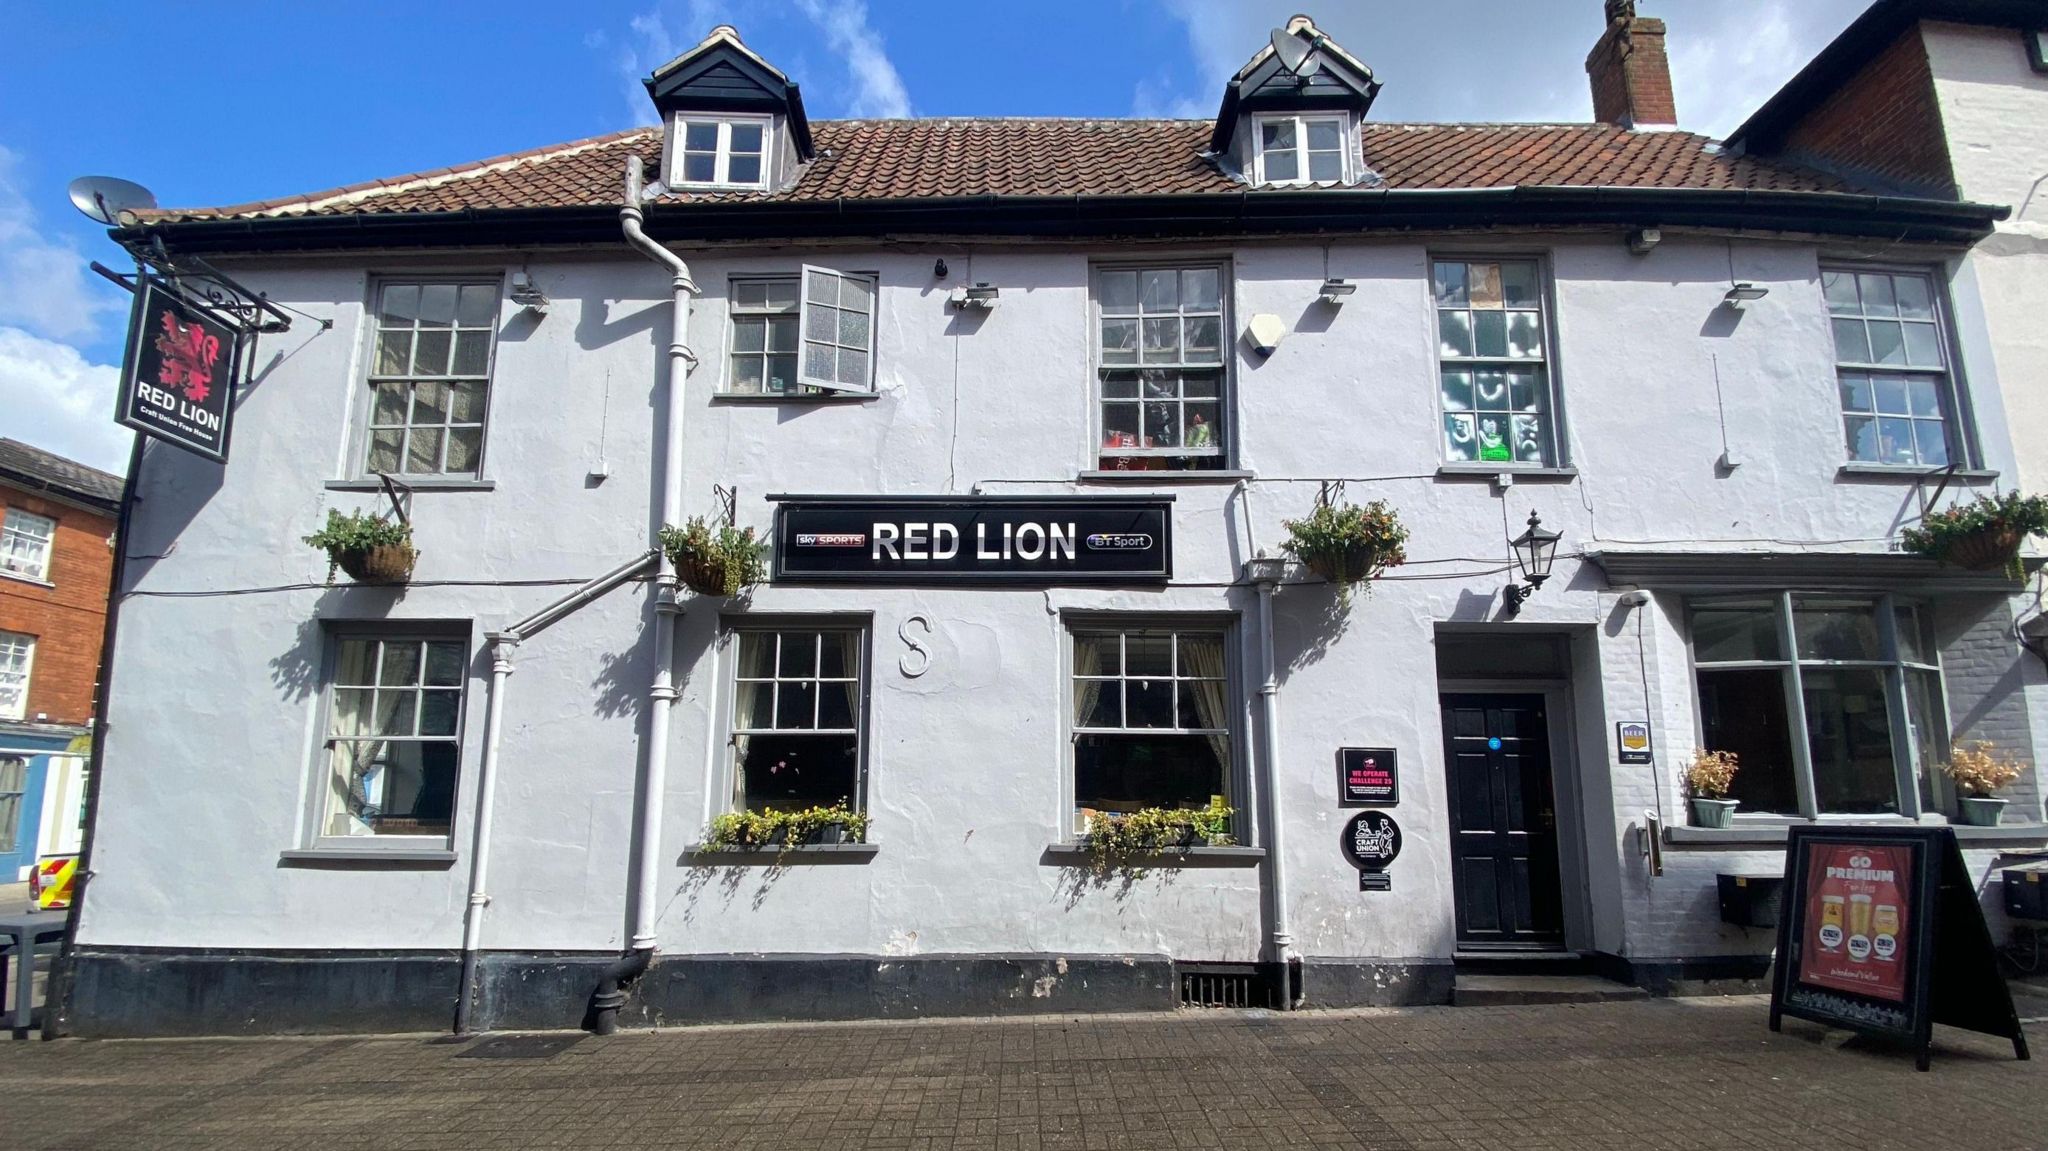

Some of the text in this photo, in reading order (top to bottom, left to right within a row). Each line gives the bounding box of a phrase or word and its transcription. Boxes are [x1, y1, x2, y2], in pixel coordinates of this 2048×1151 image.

[138, 381, 220, 431] RED LION
[140, 406, 213, 441] Craft Union Free House
[799, 535, 863, 546] sky SPORTS
[872, 522, 1076, 560] RED LION
[1094, 536, 1145, 548] BT Sport
[1849, 855, 1872, 868] GO
[1826, 866, 1894, 882] PREMIUM
